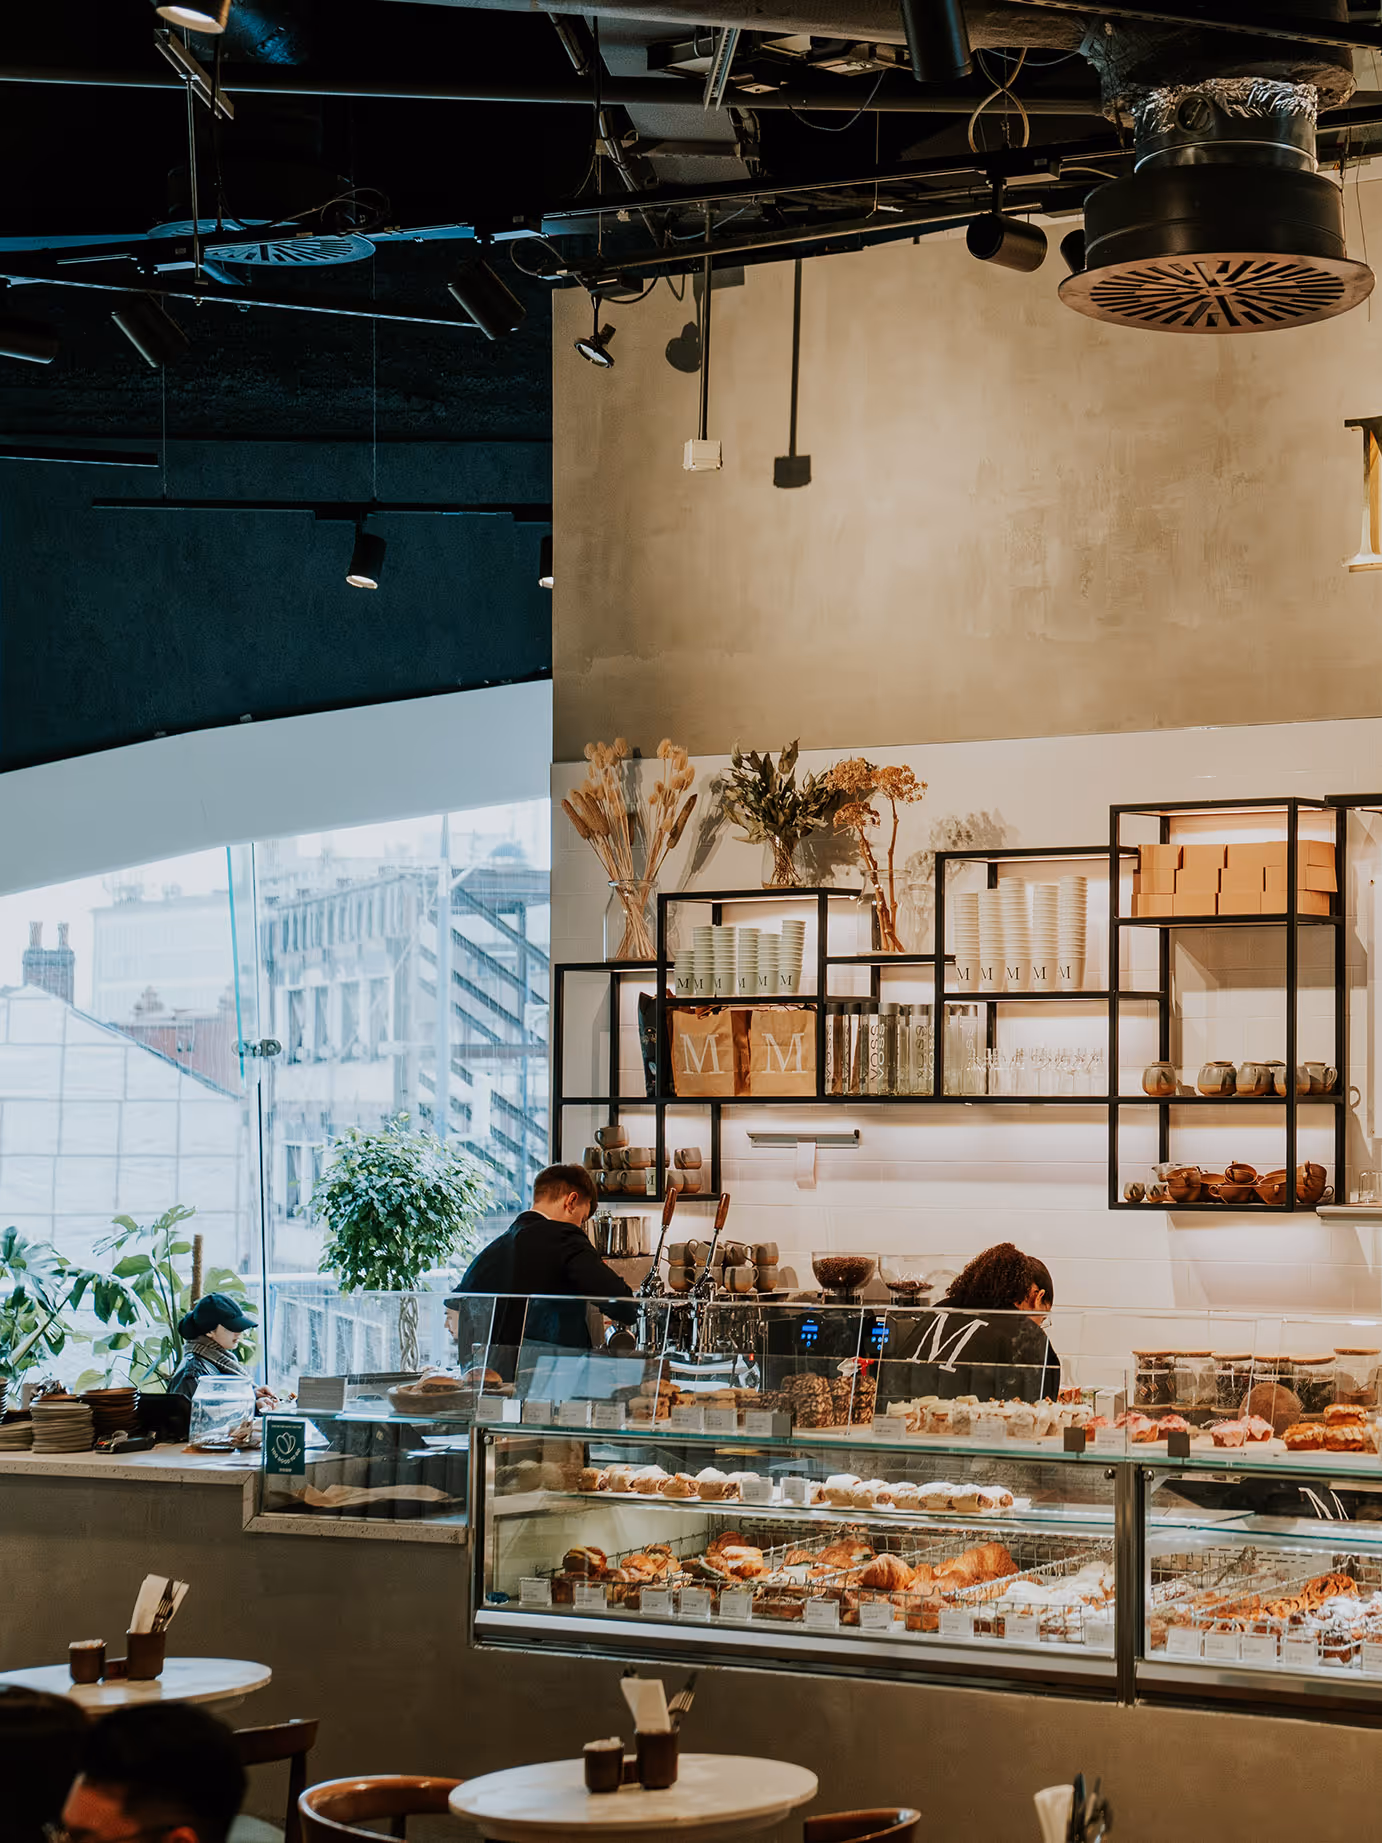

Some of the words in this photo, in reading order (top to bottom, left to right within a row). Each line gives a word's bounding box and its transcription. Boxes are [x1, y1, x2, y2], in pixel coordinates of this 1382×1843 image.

[957, 968, 970, 980] M
[981, 968, 993, 980] M
[1007, 967, 1020, 980] M
[1033, 967, 1047, 979] M
[1060, 966, 1071, 979] M
[677, 978, 690, 988] M
[694, 979, 703, 989] M
[758, 976, 767, 986] M
[780, 975, 792, 985] M
[680, 1034, 725, 1074] M
[761, 1033, 808, 1073] M
[870, 1024, 879, 1080] VOSS
[906, 1311, 989, 1373] M
